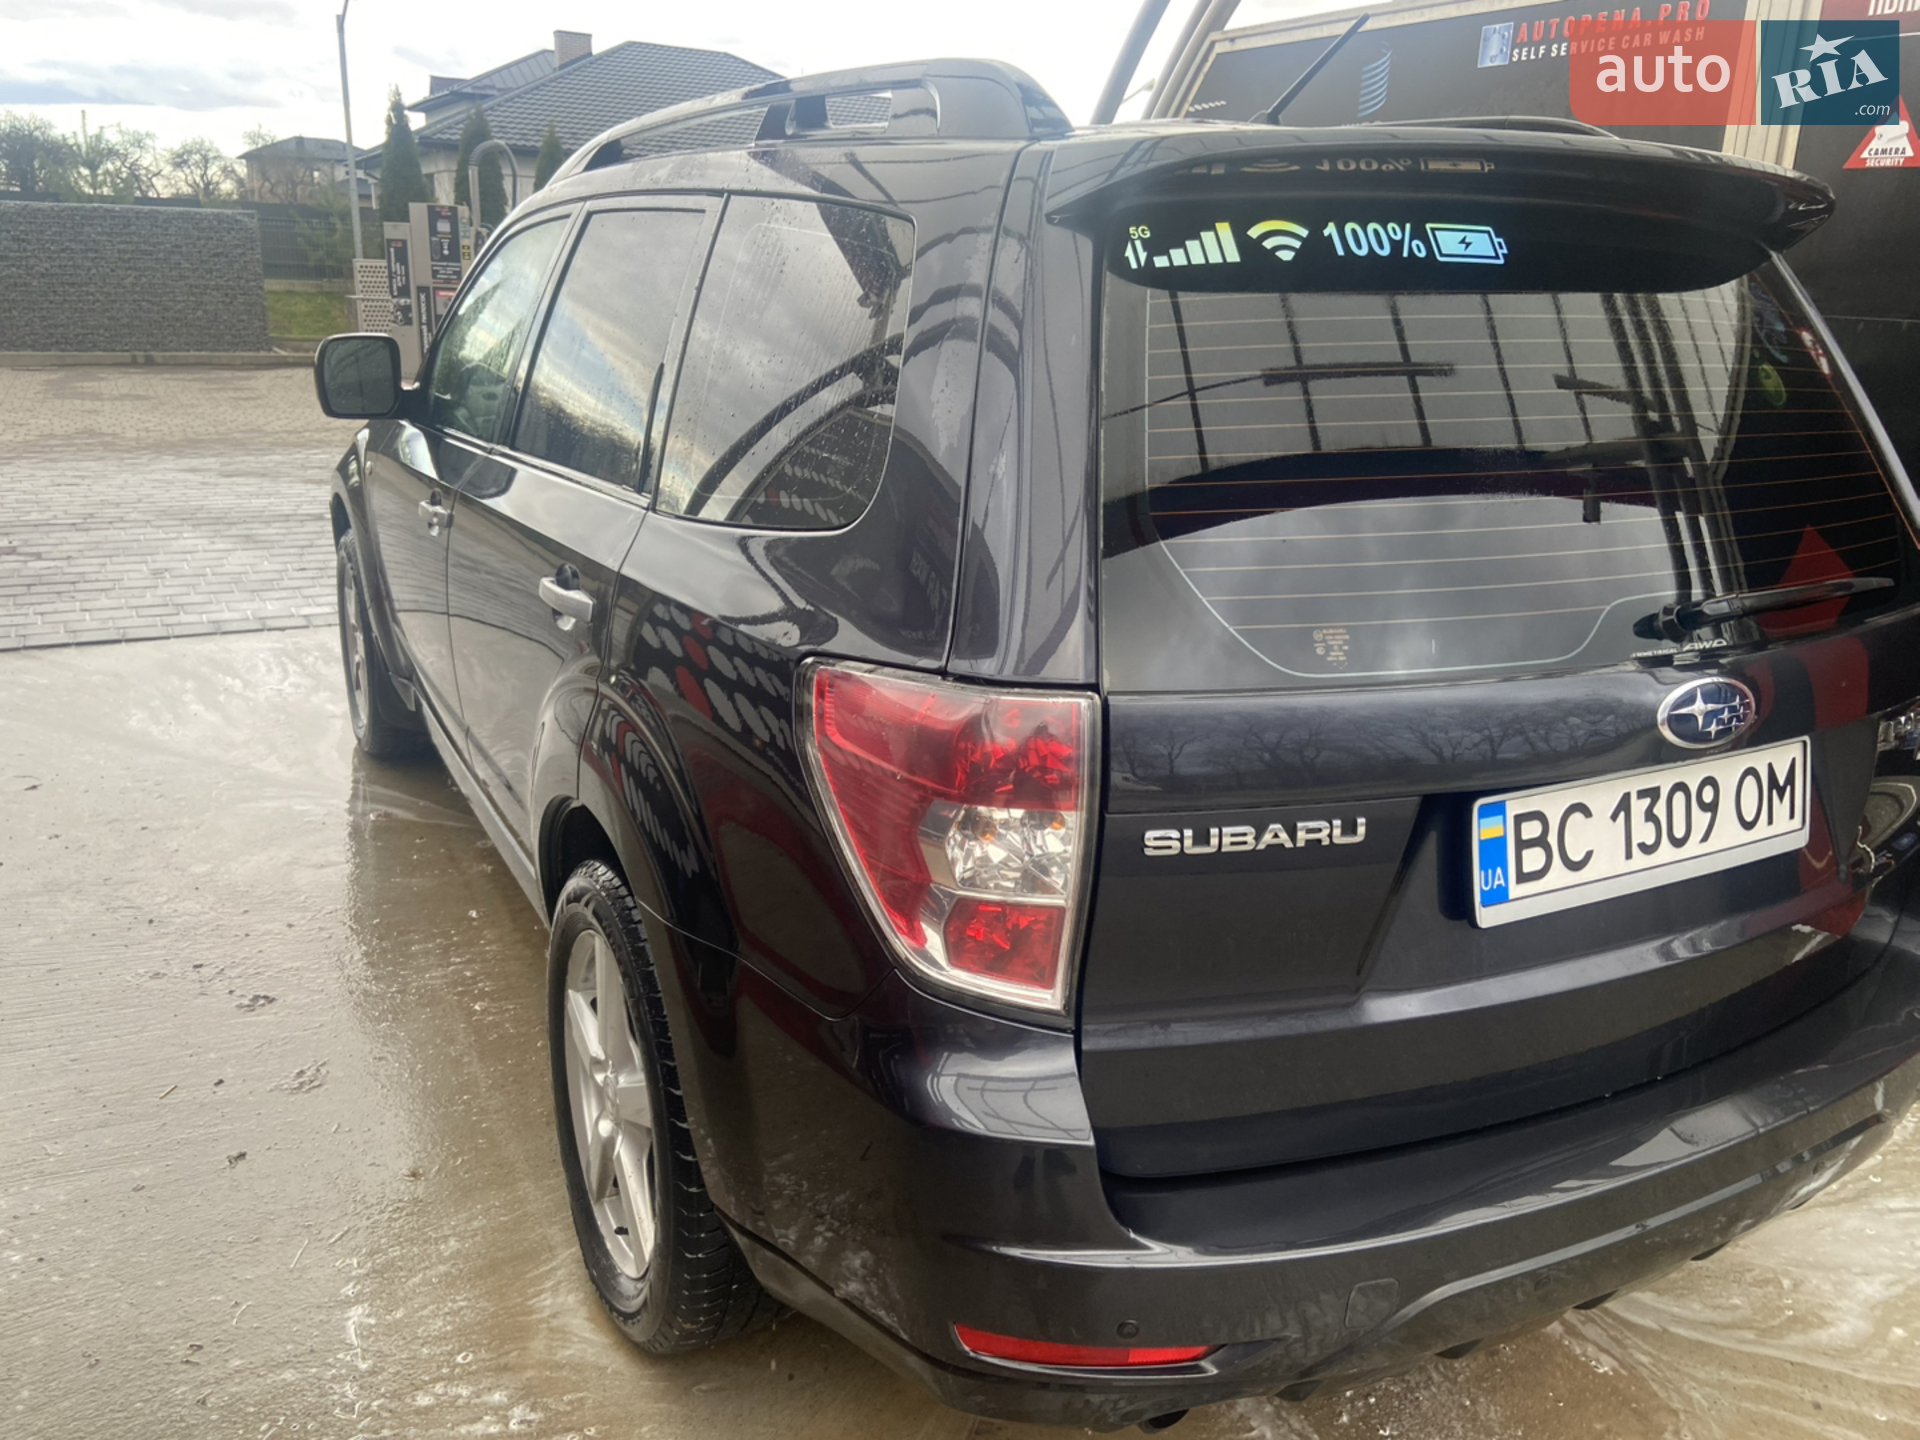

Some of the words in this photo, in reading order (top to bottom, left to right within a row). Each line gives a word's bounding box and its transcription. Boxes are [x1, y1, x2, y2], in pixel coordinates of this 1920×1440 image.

[1512, 45, 1546, 62] SELF
[1551, 37, 1615, 58] SERVICE
[1621, 33, 1652, 50] CAR
[1659, 27, 1705, 45] WASH
[1865, 156, 1905, 168] SECURITY
[1867, 146, 1907, 157] CAMERA
[1129, 226, 1151, 240] 5G
[1323, 221, 1427, 258] 100%
[1683, 639, 1728, 652] AWD
[1513, 802, 1595, 885] BC
[1609, 775, 1721, 861] 1309
[1734, 756, 1797, 831] OM
[1143, 817, 1366, 856] SUBARU
[1480, 867, 1506, 891] UA
